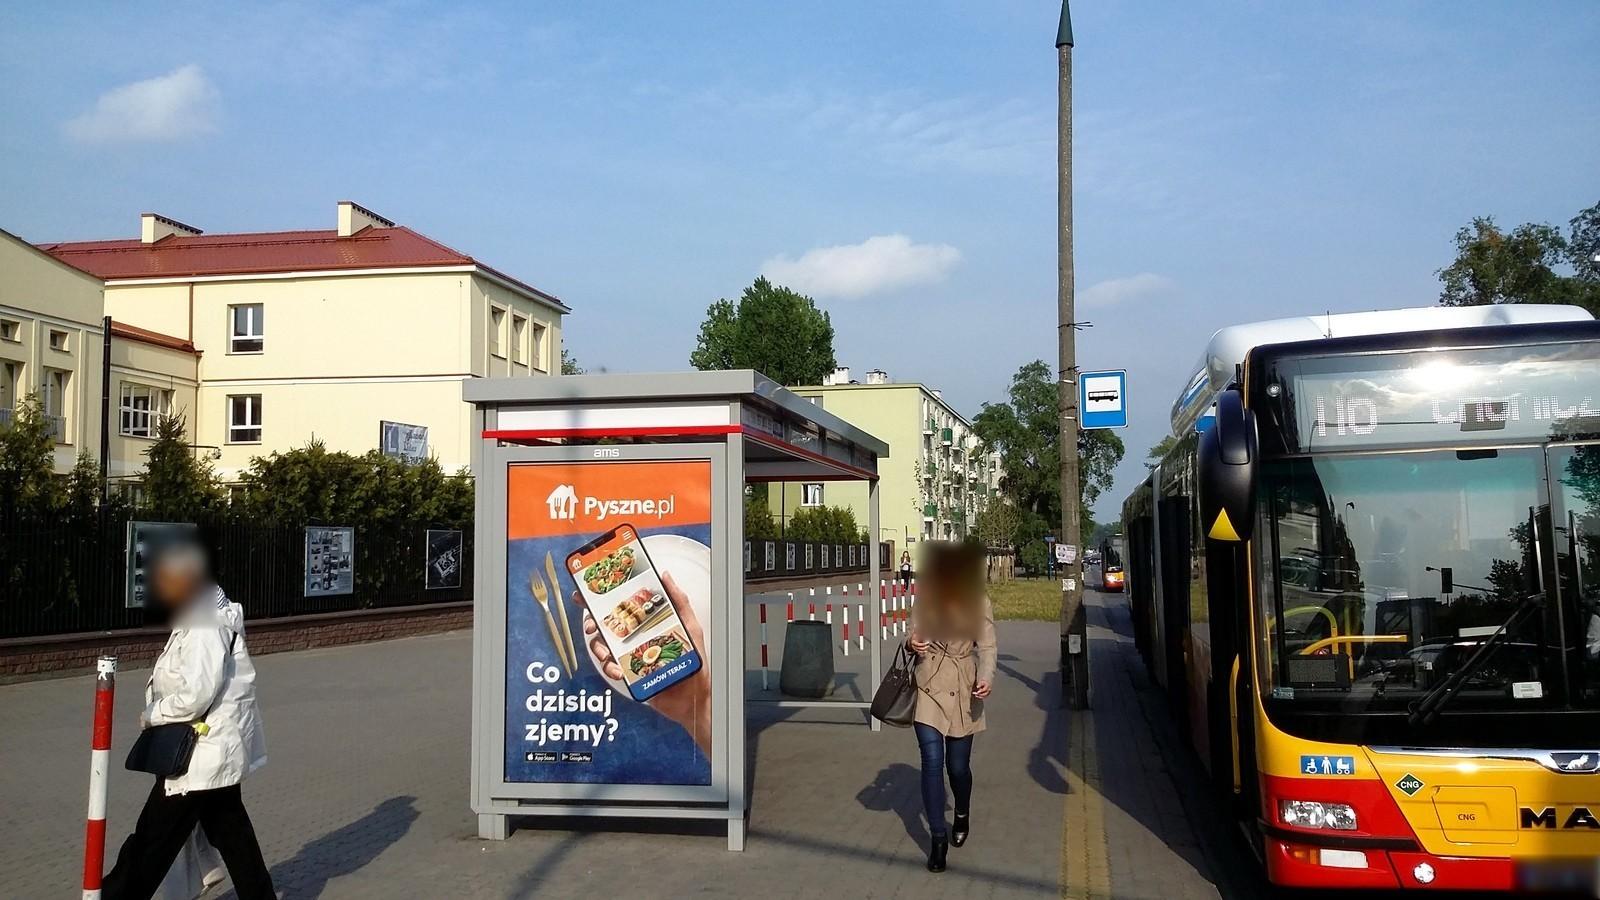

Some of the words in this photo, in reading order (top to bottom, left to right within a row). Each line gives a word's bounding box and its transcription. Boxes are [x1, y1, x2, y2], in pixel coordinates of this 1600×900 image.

[593, 448, 620, 458] ams
[584, 495, 674, 520] Pyszne.pl
[526, 661, 560, 683] Co
[642, 672, 667, 690] ZAMÓW
[667, 661, 687, 676] TERAZ
[526, 689, 612, 717] dzisiaj
[525, 718, 619, 747] zjemy?
[1400, 781, 1420, 789] CNG
[1457, 813, 1476, 821] CNG
